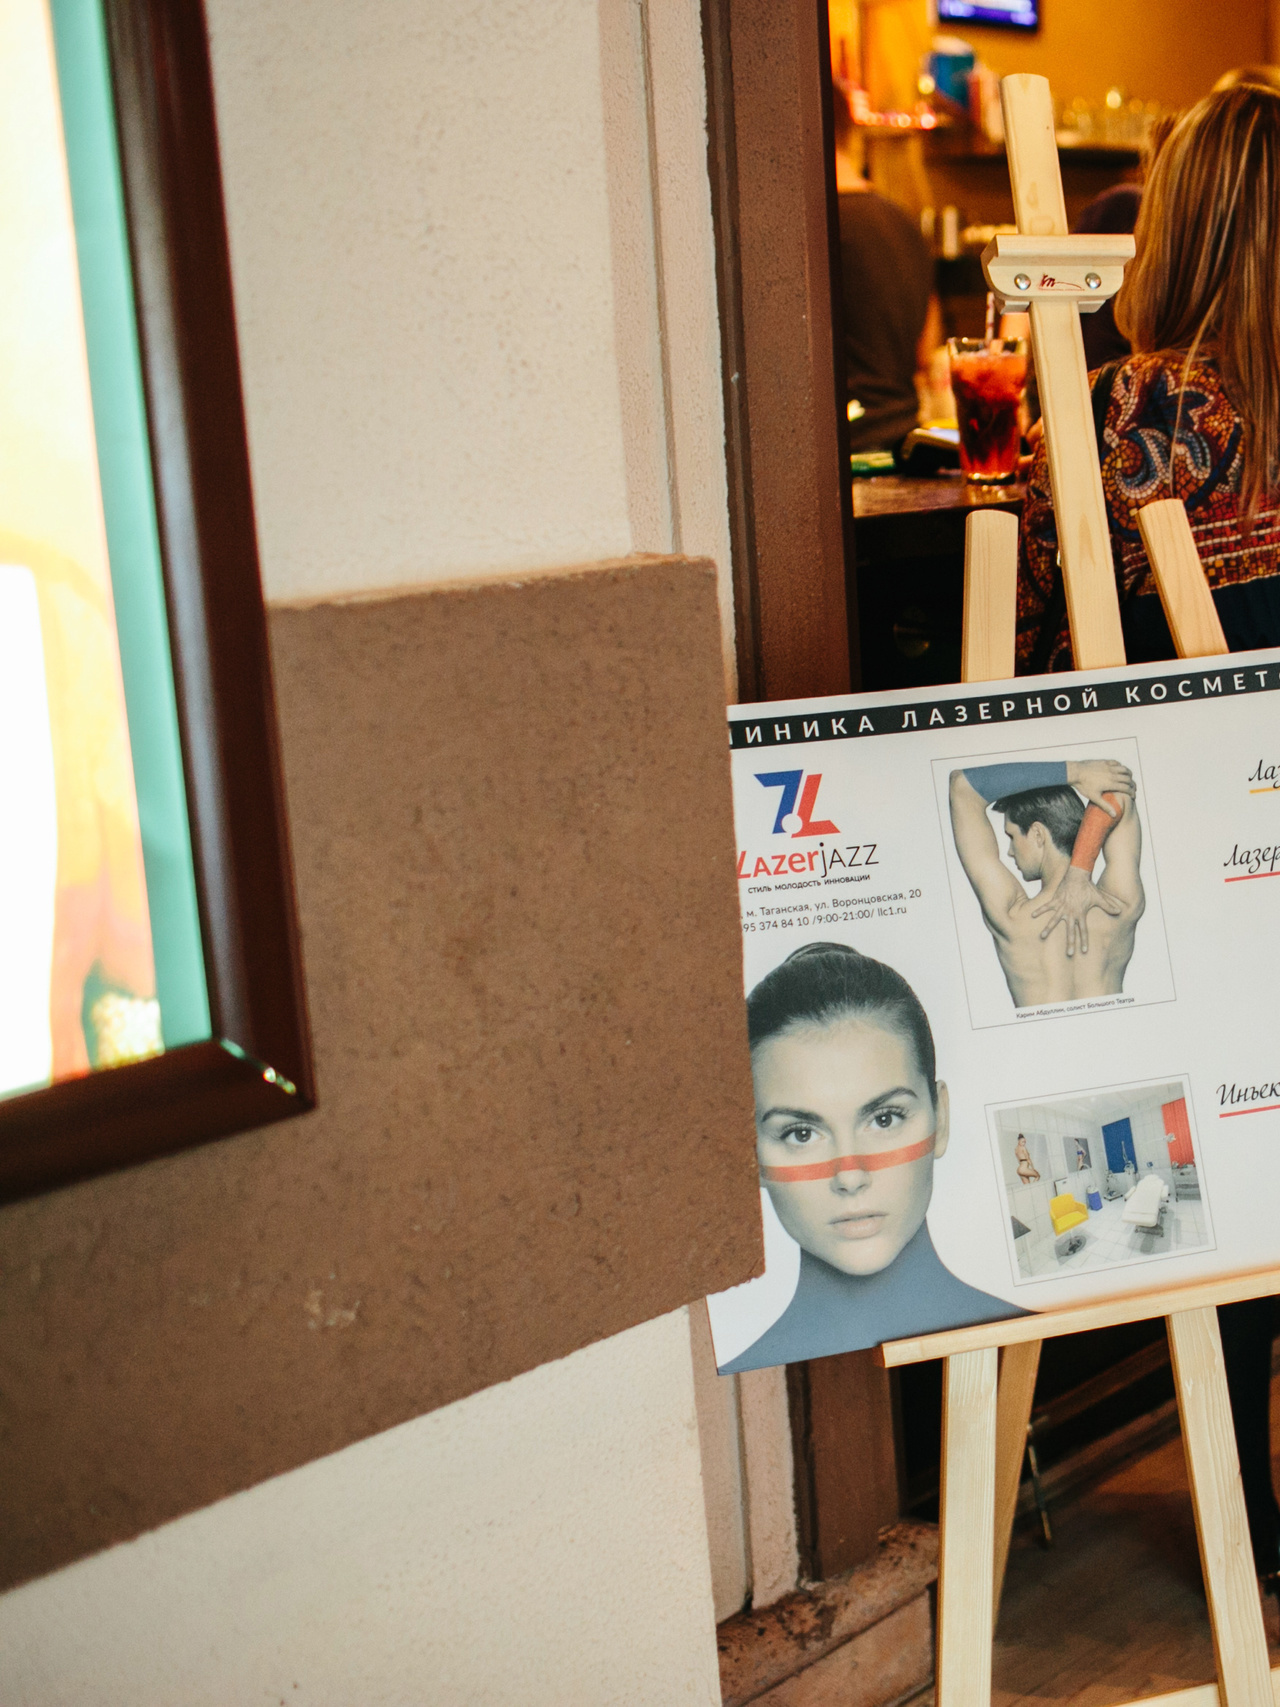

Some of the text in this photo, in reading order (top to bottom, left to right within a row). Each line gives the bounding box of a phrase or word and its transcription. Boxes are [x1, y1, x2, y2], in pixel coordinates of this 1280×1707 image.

[729, 715, 875, 745] ИНИКА
[901, 687, 1099, 729] ЛАЗЕРНОЙ
[759, 903, 813, 917] Таганская,
[814, 902, 830, 911] ул.
[832, 892, 907, 909] Воронцовская,
[908, 888, 922, 899] 20
[741, 922, 756, 933] 95
[759, 920, 778, 931] 374
[781, 918, 794, 928] 84
[796, 916, 809, 926] 10
